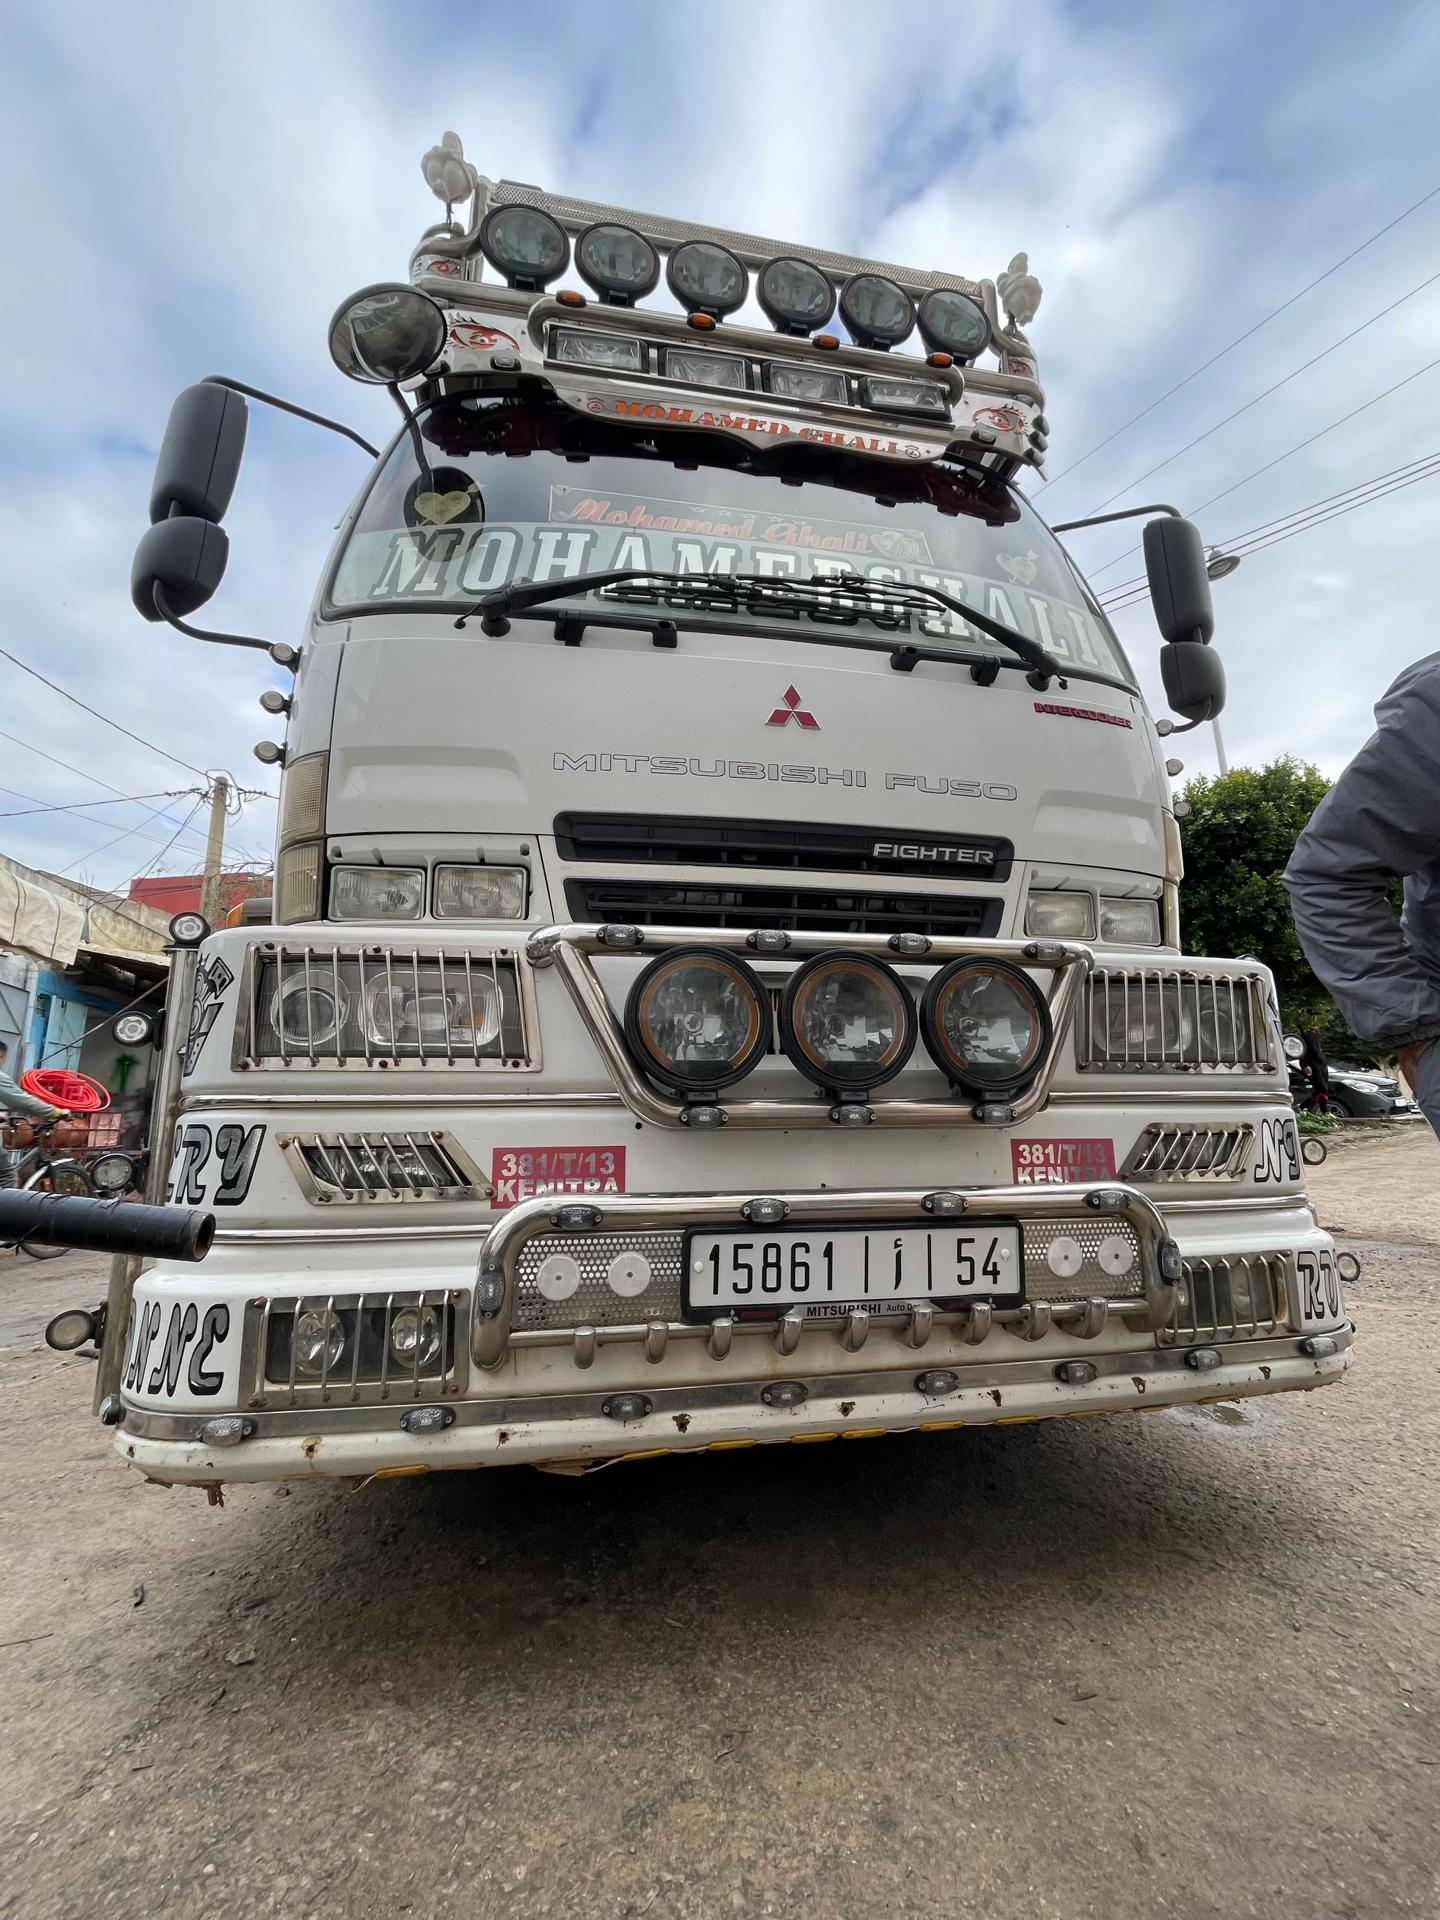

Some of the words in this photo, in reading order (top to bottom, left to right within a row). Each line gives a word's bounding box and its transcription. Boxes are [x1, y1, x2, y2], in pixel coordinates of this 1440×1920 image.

[612, 400, 790, 435] MOHAMED
[799, 428, 898, 454] GHALI
[567, 499, 757, 540] Mohamed
[762, 522, 872, 553] Ghali
[1034, 703, 1133, 729] INTERCOOLER
[553, 752, 867, 788] MITSUBISHI
[885, 773, 1018, 801] FUSO
[872, 843, 995, 865] FIGHTER
[501, 1152, 615, 1177] 381/T/13
[1018, 1143, 1106, 1165] 381/T/13
[1017, 1166, 1111, 1184] KENITRA
[497, 1177, 618, 1202] KENITRA
[709, 1241, 833, 1295] 15861
[956, 1236, 1001, 1286] 54
[886, 1303, 905, 1312] Auto
